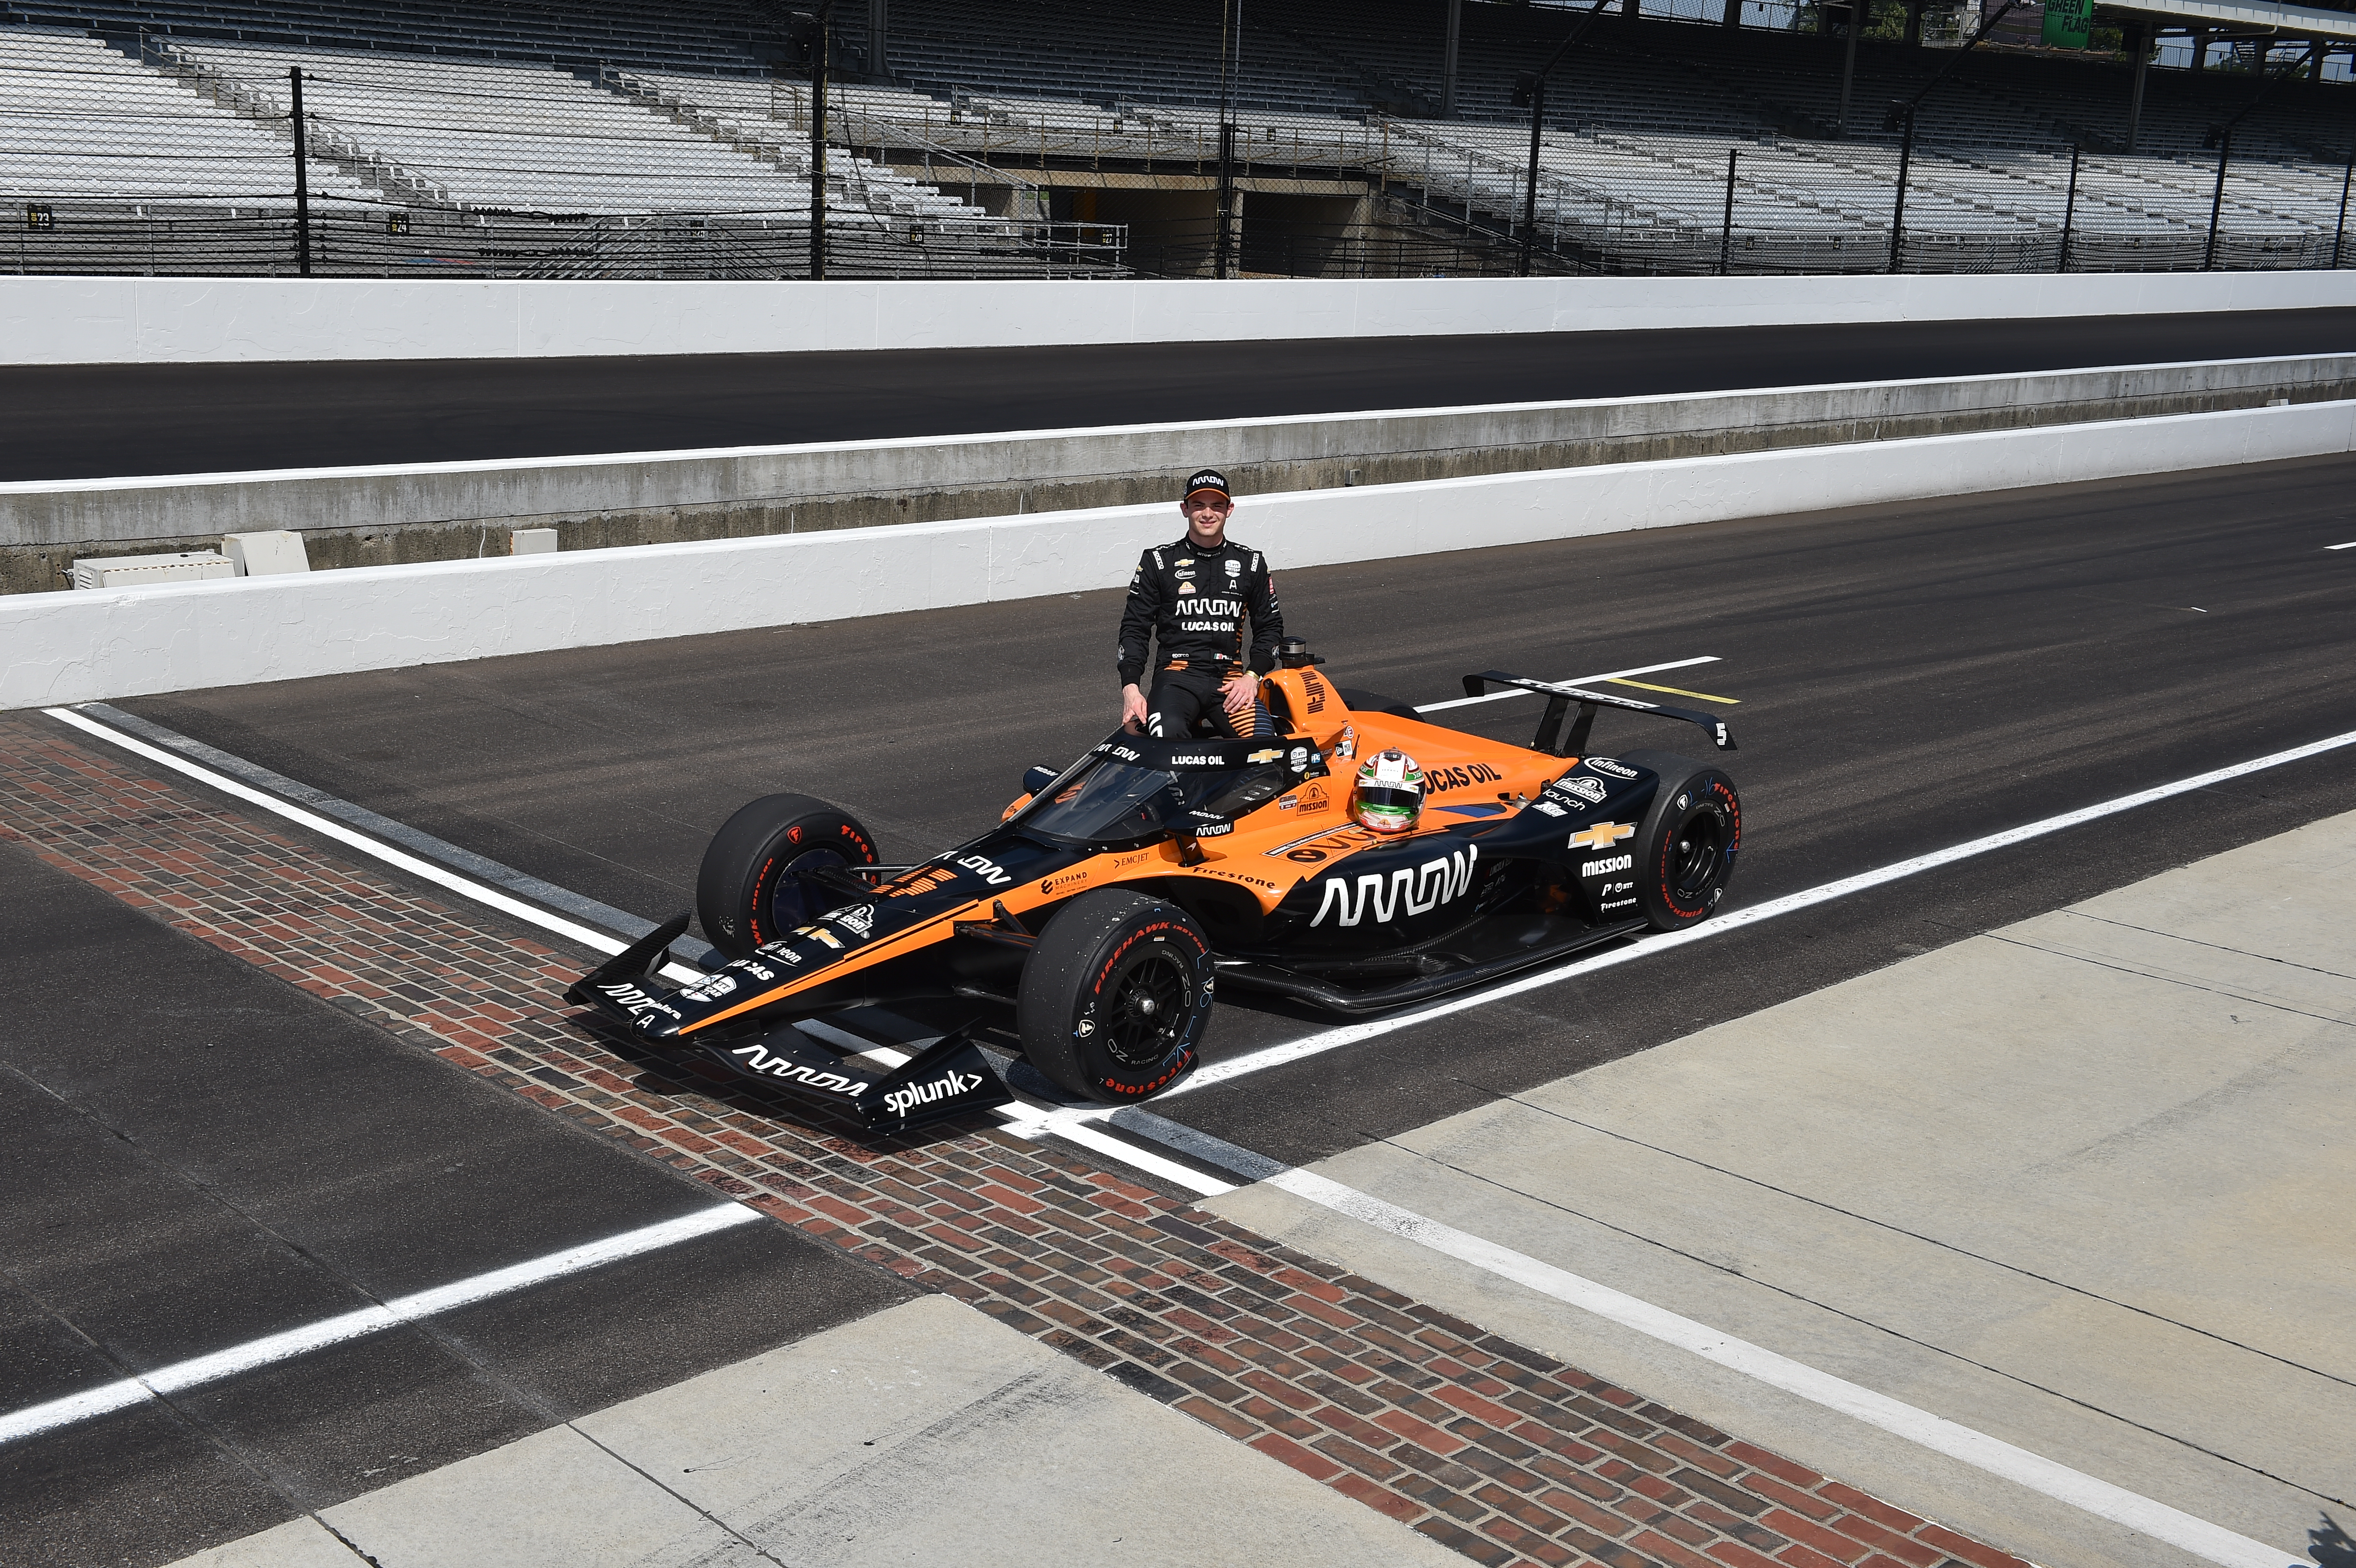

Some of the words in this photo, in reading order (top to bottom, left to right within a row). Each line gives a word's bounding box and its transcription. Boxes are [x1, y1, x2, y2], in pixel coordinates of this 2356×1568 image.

[2062, 15, 2089, 33] FLAG
[1192, 476, 1224, 487] ARROW
[1175, 599, 1242, 617] ARROW
[1181, 621, 1219, 631] LUCAS
[1220, 622, 1234, 632] OIL
[1172, 756, 1206, 765] LUCAS
[1208, 756, 1225, 765] OIL
[1423, 767, 1471, 795] UCAS
[1466, 763, 1503, 784] OIL
[1542, 789, 1586, 811] launch
[1196, 823, 1231, 836] ARROW
[1121, 852, 1150, 866] EMCJET
[1055, 872, 1087, 885] EXPAND
[1055, 879, 1088, 890] MACHINERY
[1192, 867, 1276, 889] Firestone
[1309, 844, 1478, 927] ARROW
[1601, 897, 1636, 911] Firestone
[1094, 922, 1170, 995] FIREHAWK
[1131, 1054, 1159, 1066] RACING
[732, 1045, 869, 1097] ARROW
[1105, 1050, 1192, 1095] Firestone
